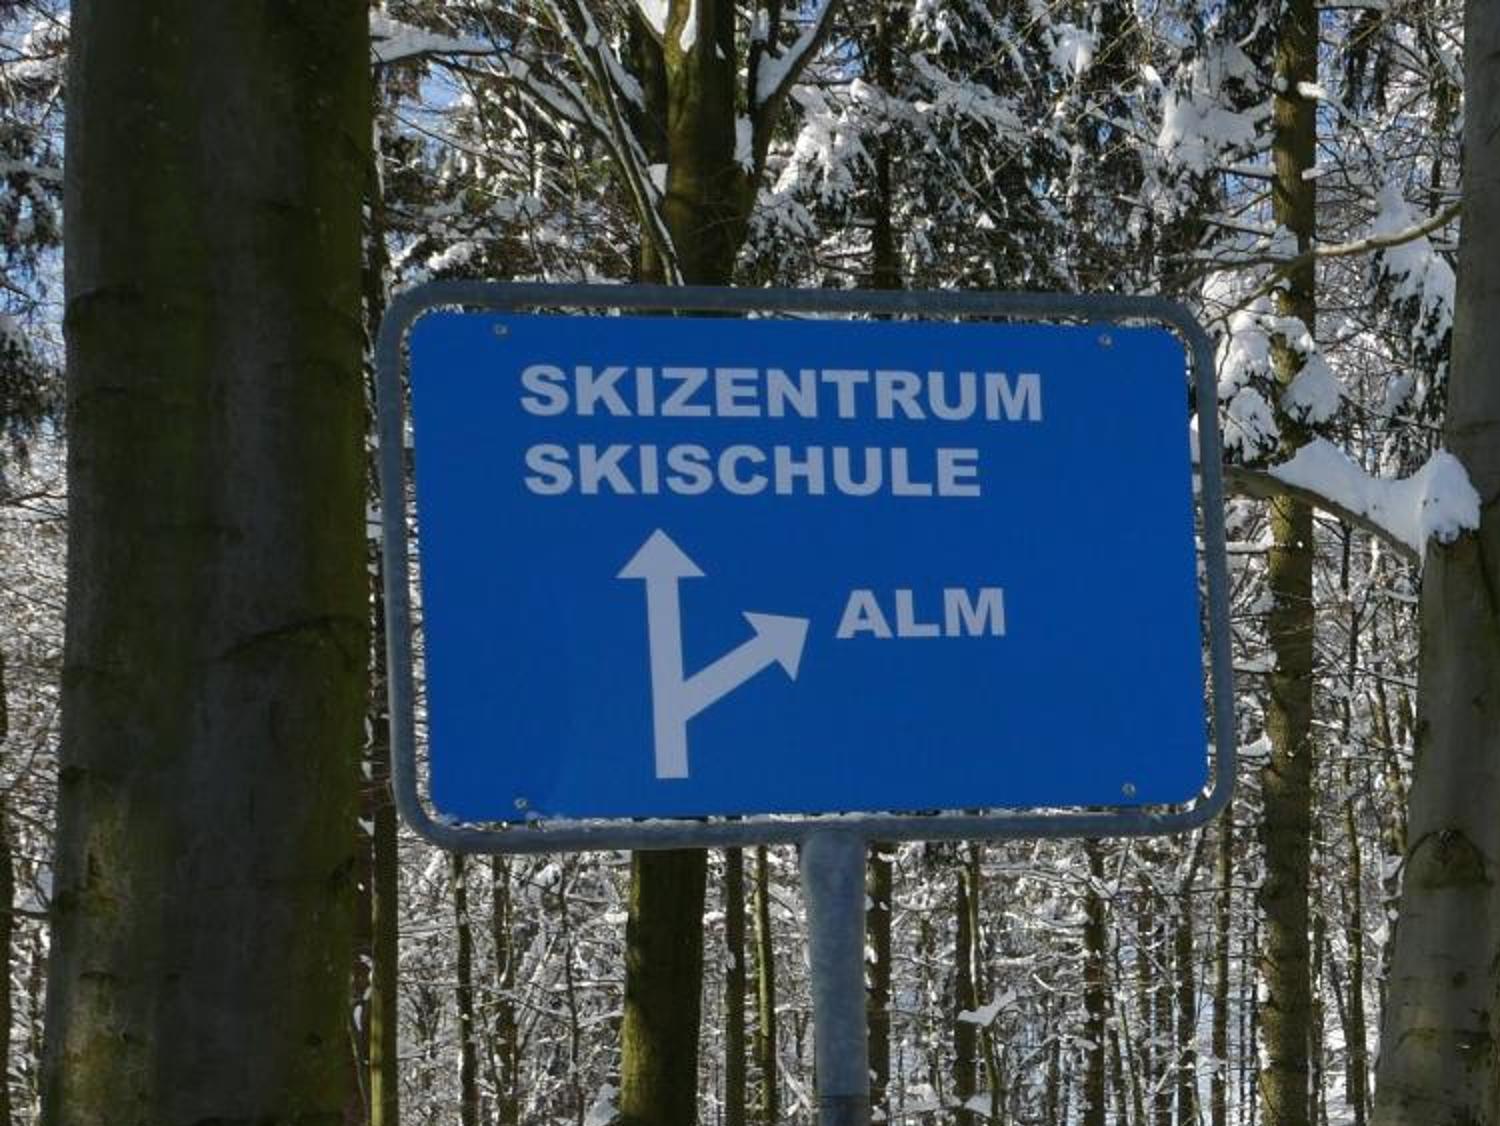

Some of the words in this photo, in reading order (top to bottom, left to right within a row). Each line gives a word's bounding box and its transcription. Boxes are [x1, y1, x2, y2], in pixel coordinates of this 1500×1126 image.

[521, 365, 1041, 420] SKIZENTRUM
[525, 444, 981, 497] SKISCHULE
[836, 588, 1006, 639] ALM
